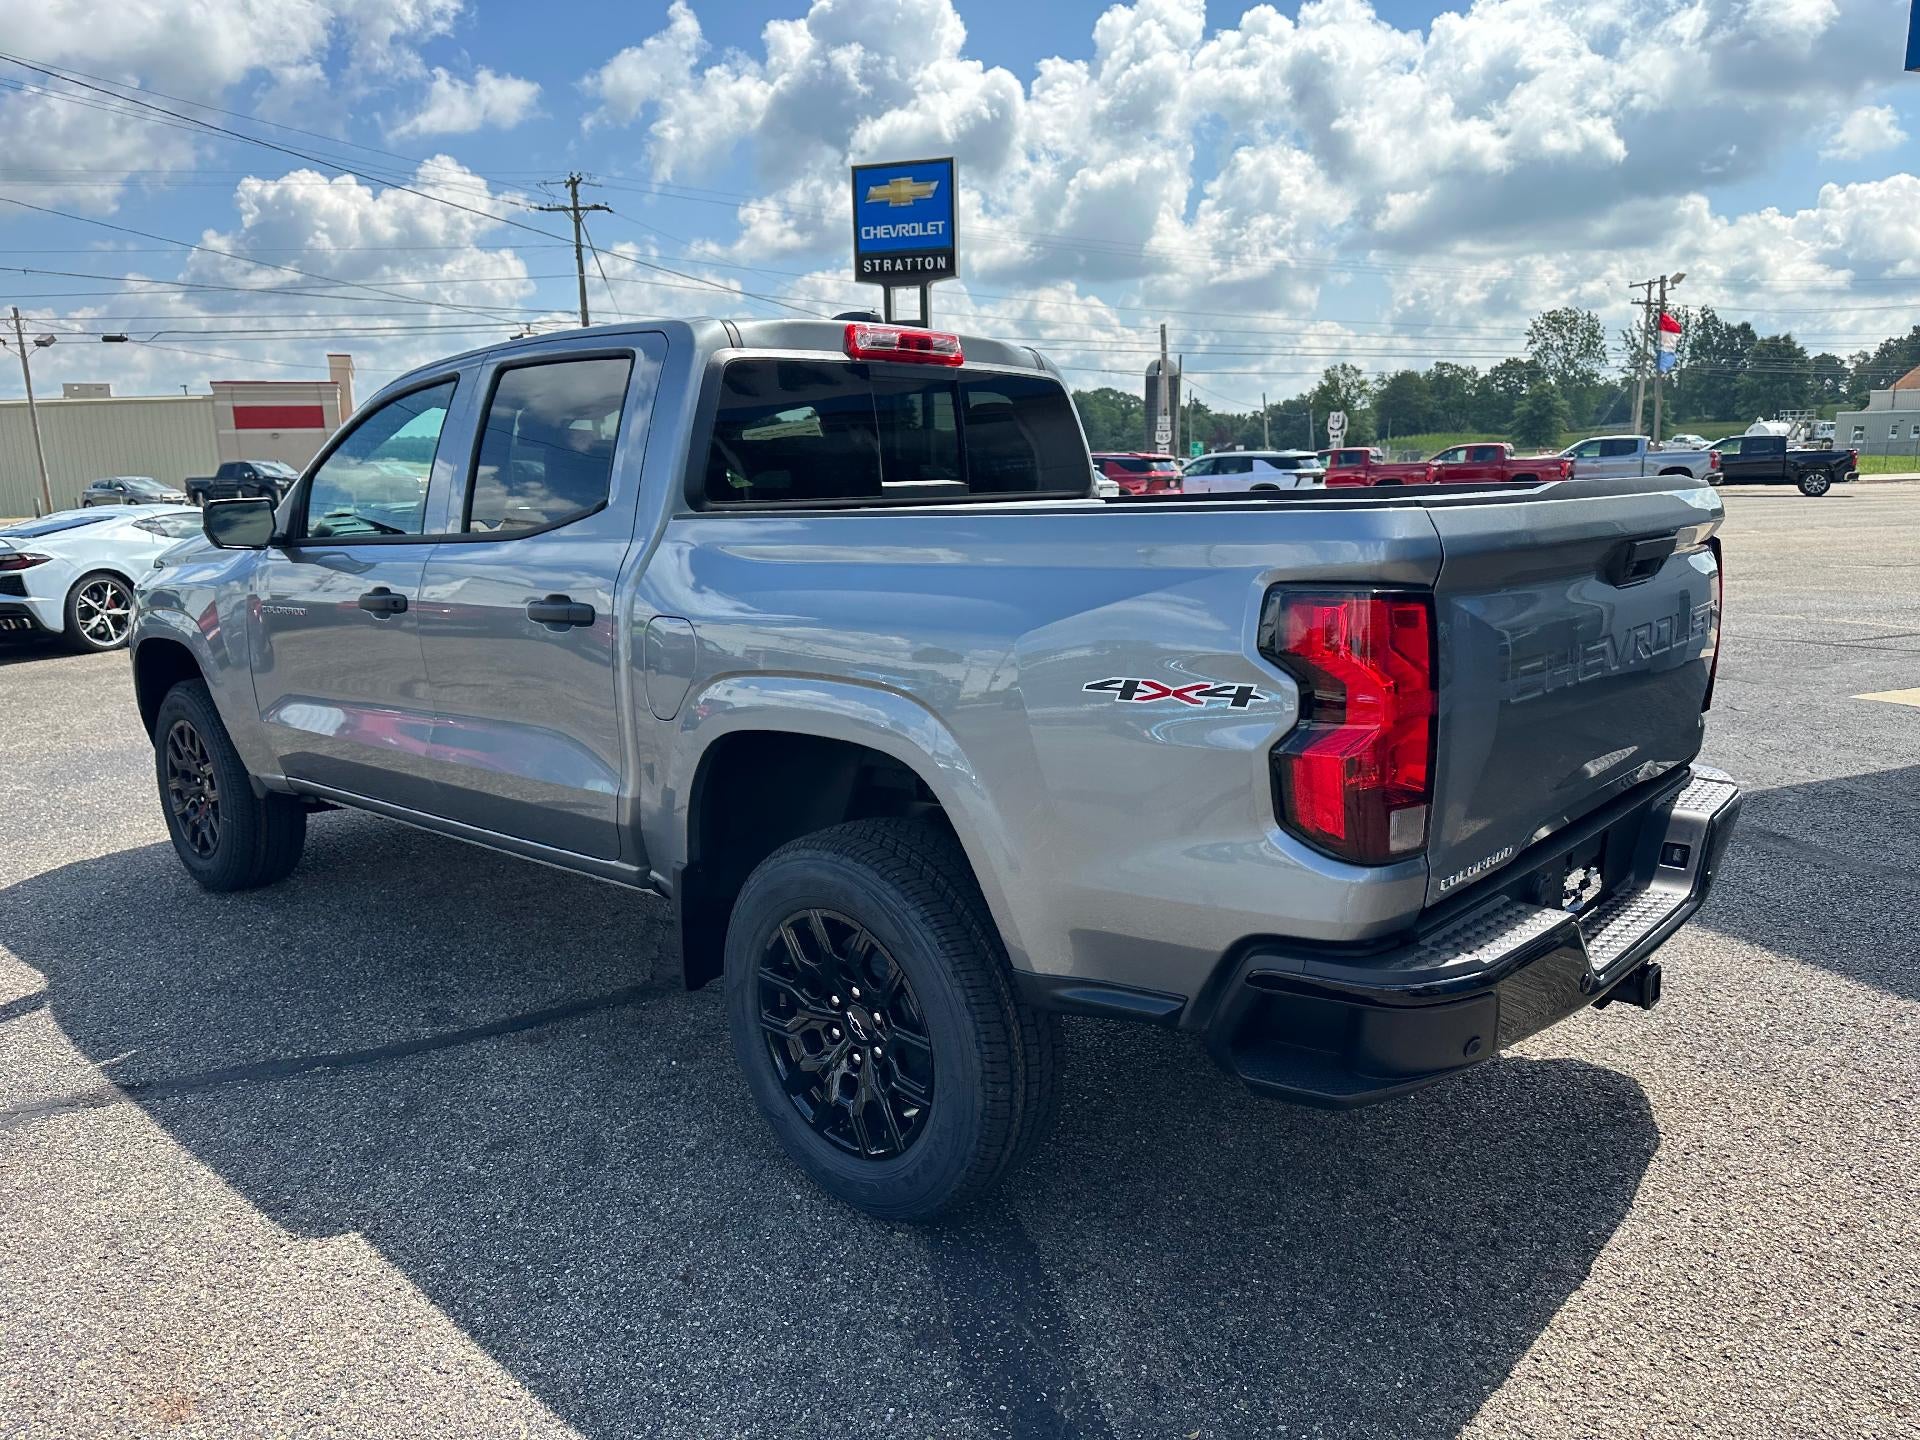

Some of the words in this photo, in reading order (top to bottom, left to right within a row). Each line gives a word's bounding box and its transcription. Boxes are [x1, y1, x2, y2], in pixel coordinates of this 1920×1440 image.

[861, 221, 945, 240] CHEVROLET
[863, 256, 946, 272] STRATTON
[262, 605, 306, 615] COLORADO
[1509, 600, 1716, 703] CHEVROLET
[1440, 847, 1512, 891] COLORADO
